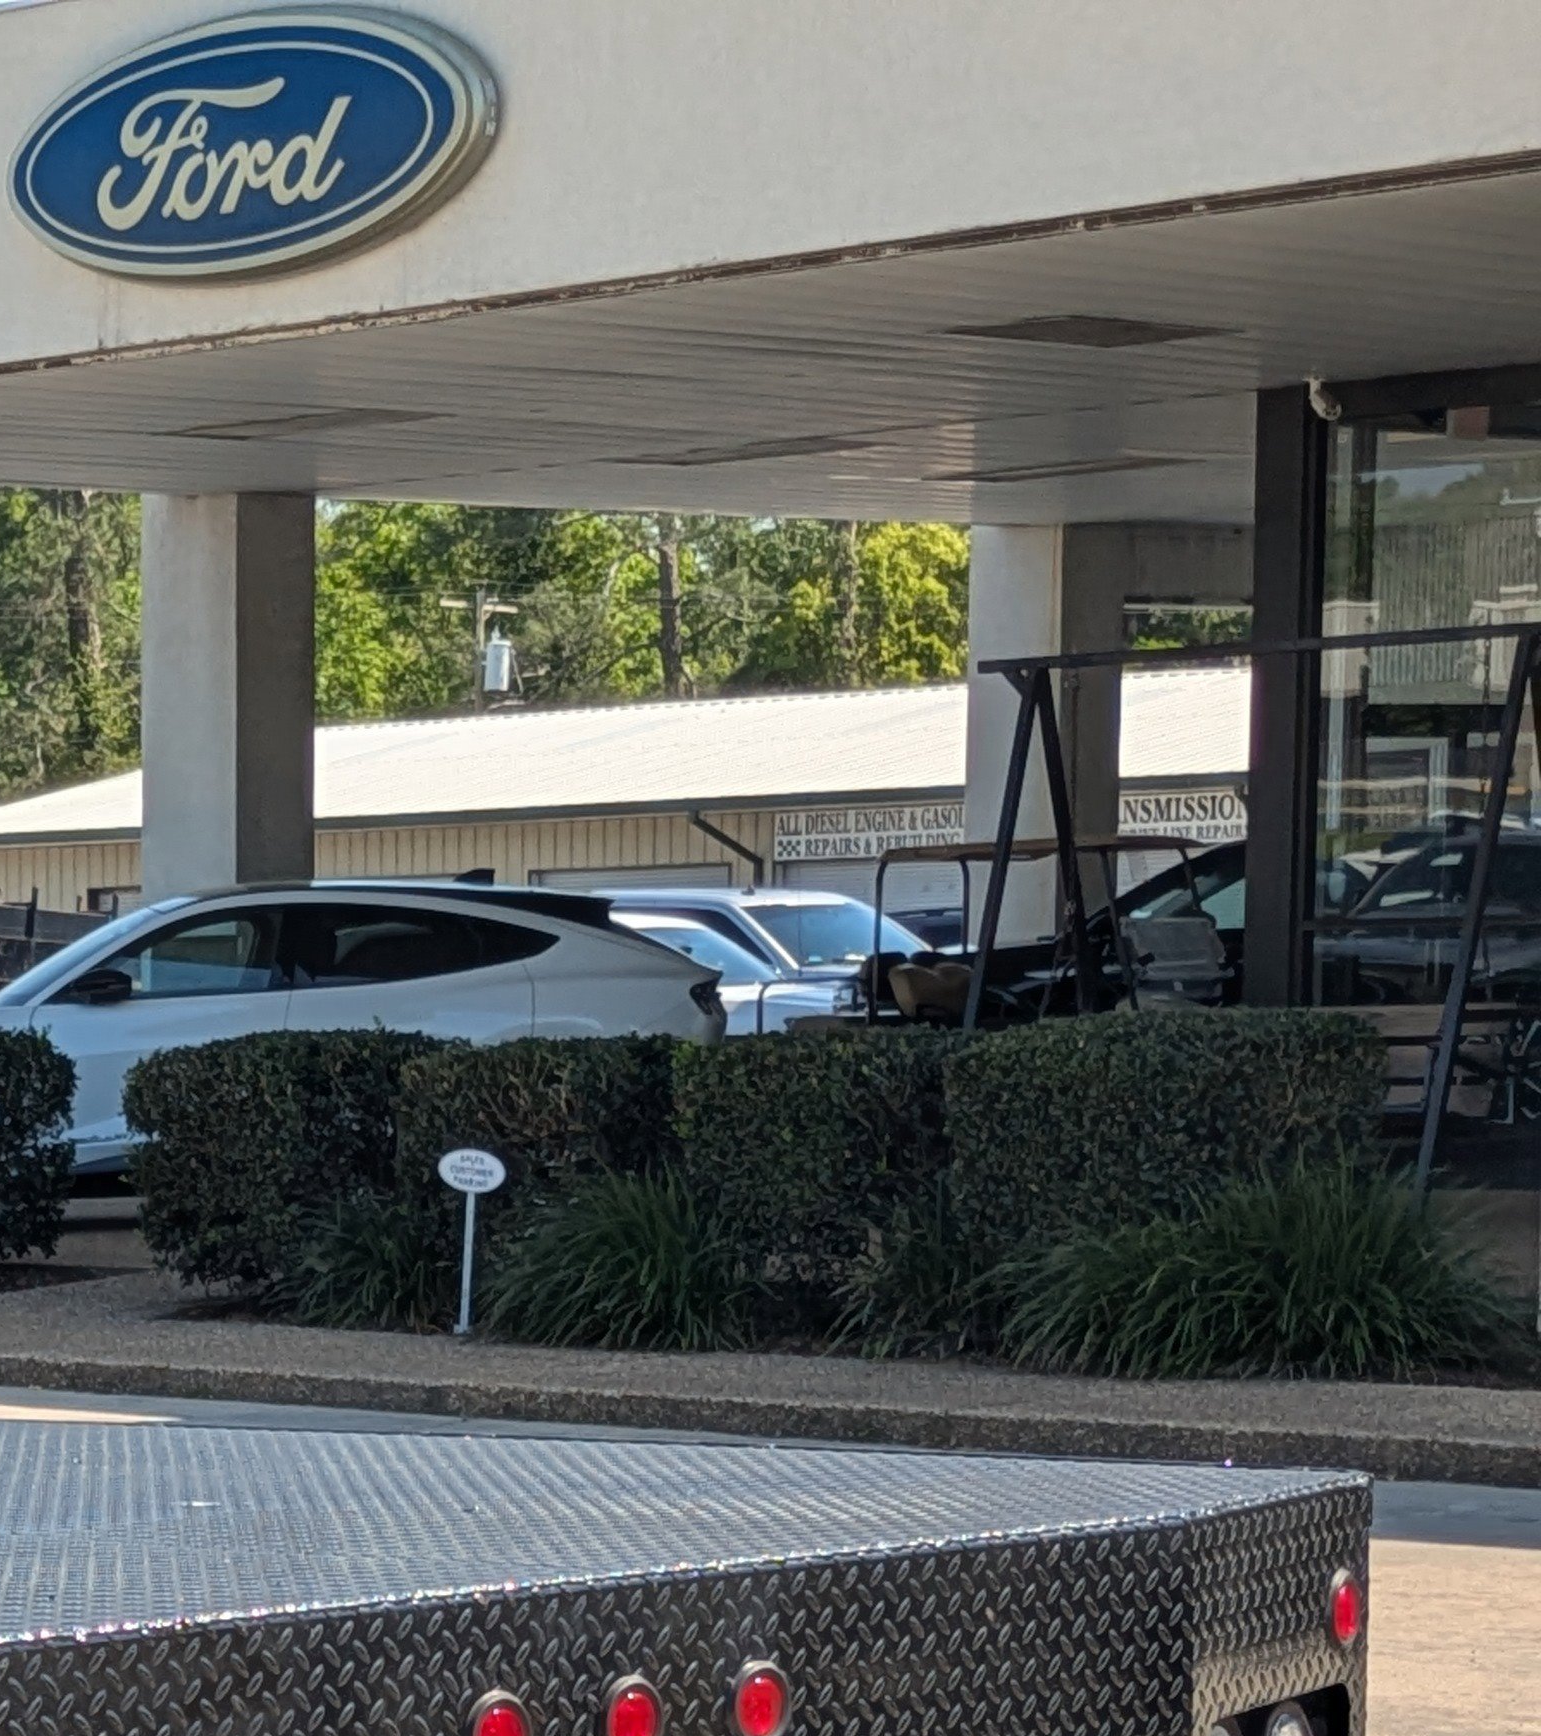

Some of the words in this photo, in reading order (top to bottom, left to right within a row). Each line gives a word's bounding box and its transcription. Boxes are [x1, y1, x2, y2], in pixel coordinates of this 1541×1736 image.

[97, 76, 352, 230] Ford
[777, 814, 802, 836] ALL
[804, 811, 851, 836] DIESEL
[854, 808, 905, 833] ENGINE
[908, 809, 917, 830] &
[804, 837, 861, 857] REPAIRS
[864, 836, 872, 855] &
